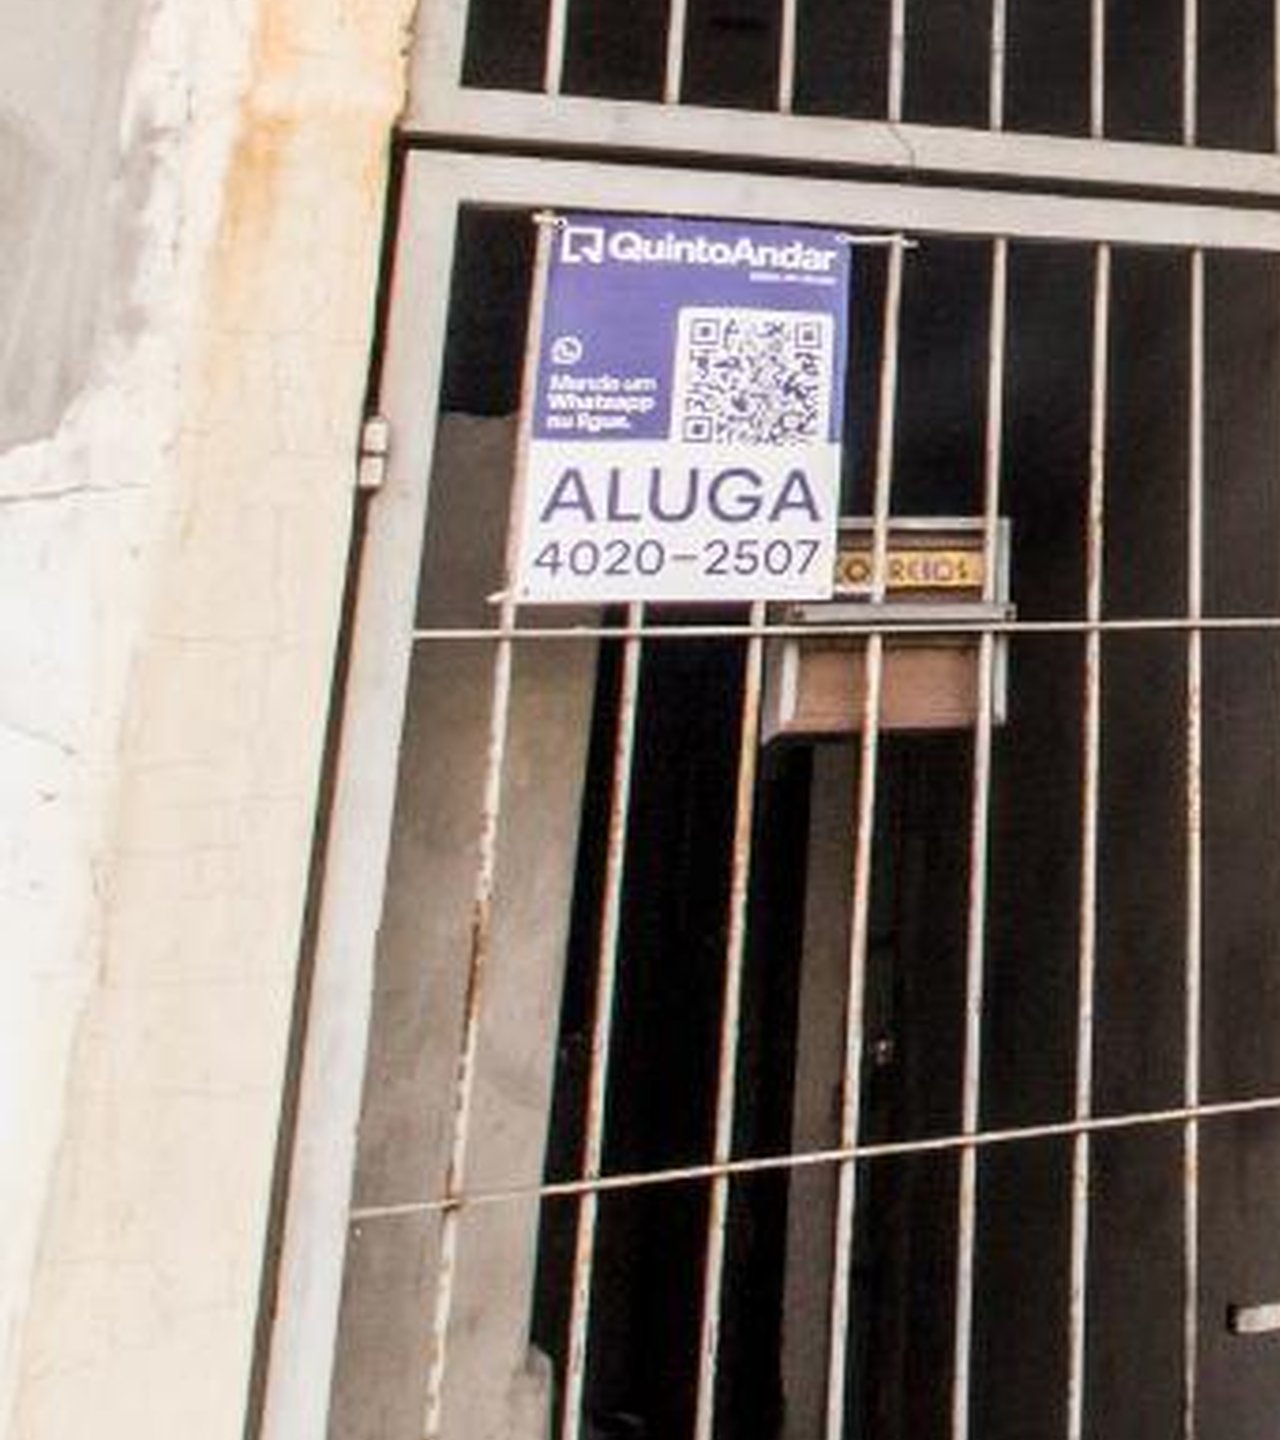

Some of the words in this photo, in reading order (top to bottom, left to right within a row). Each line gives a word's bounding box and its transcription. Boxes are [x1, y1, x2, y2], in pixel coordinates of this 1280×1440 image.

[608, 229, 837, 271] QuintoAndar
[540, 466, 821, 523] ALUGA
[534, 538, 821, 576] 4020-2507
